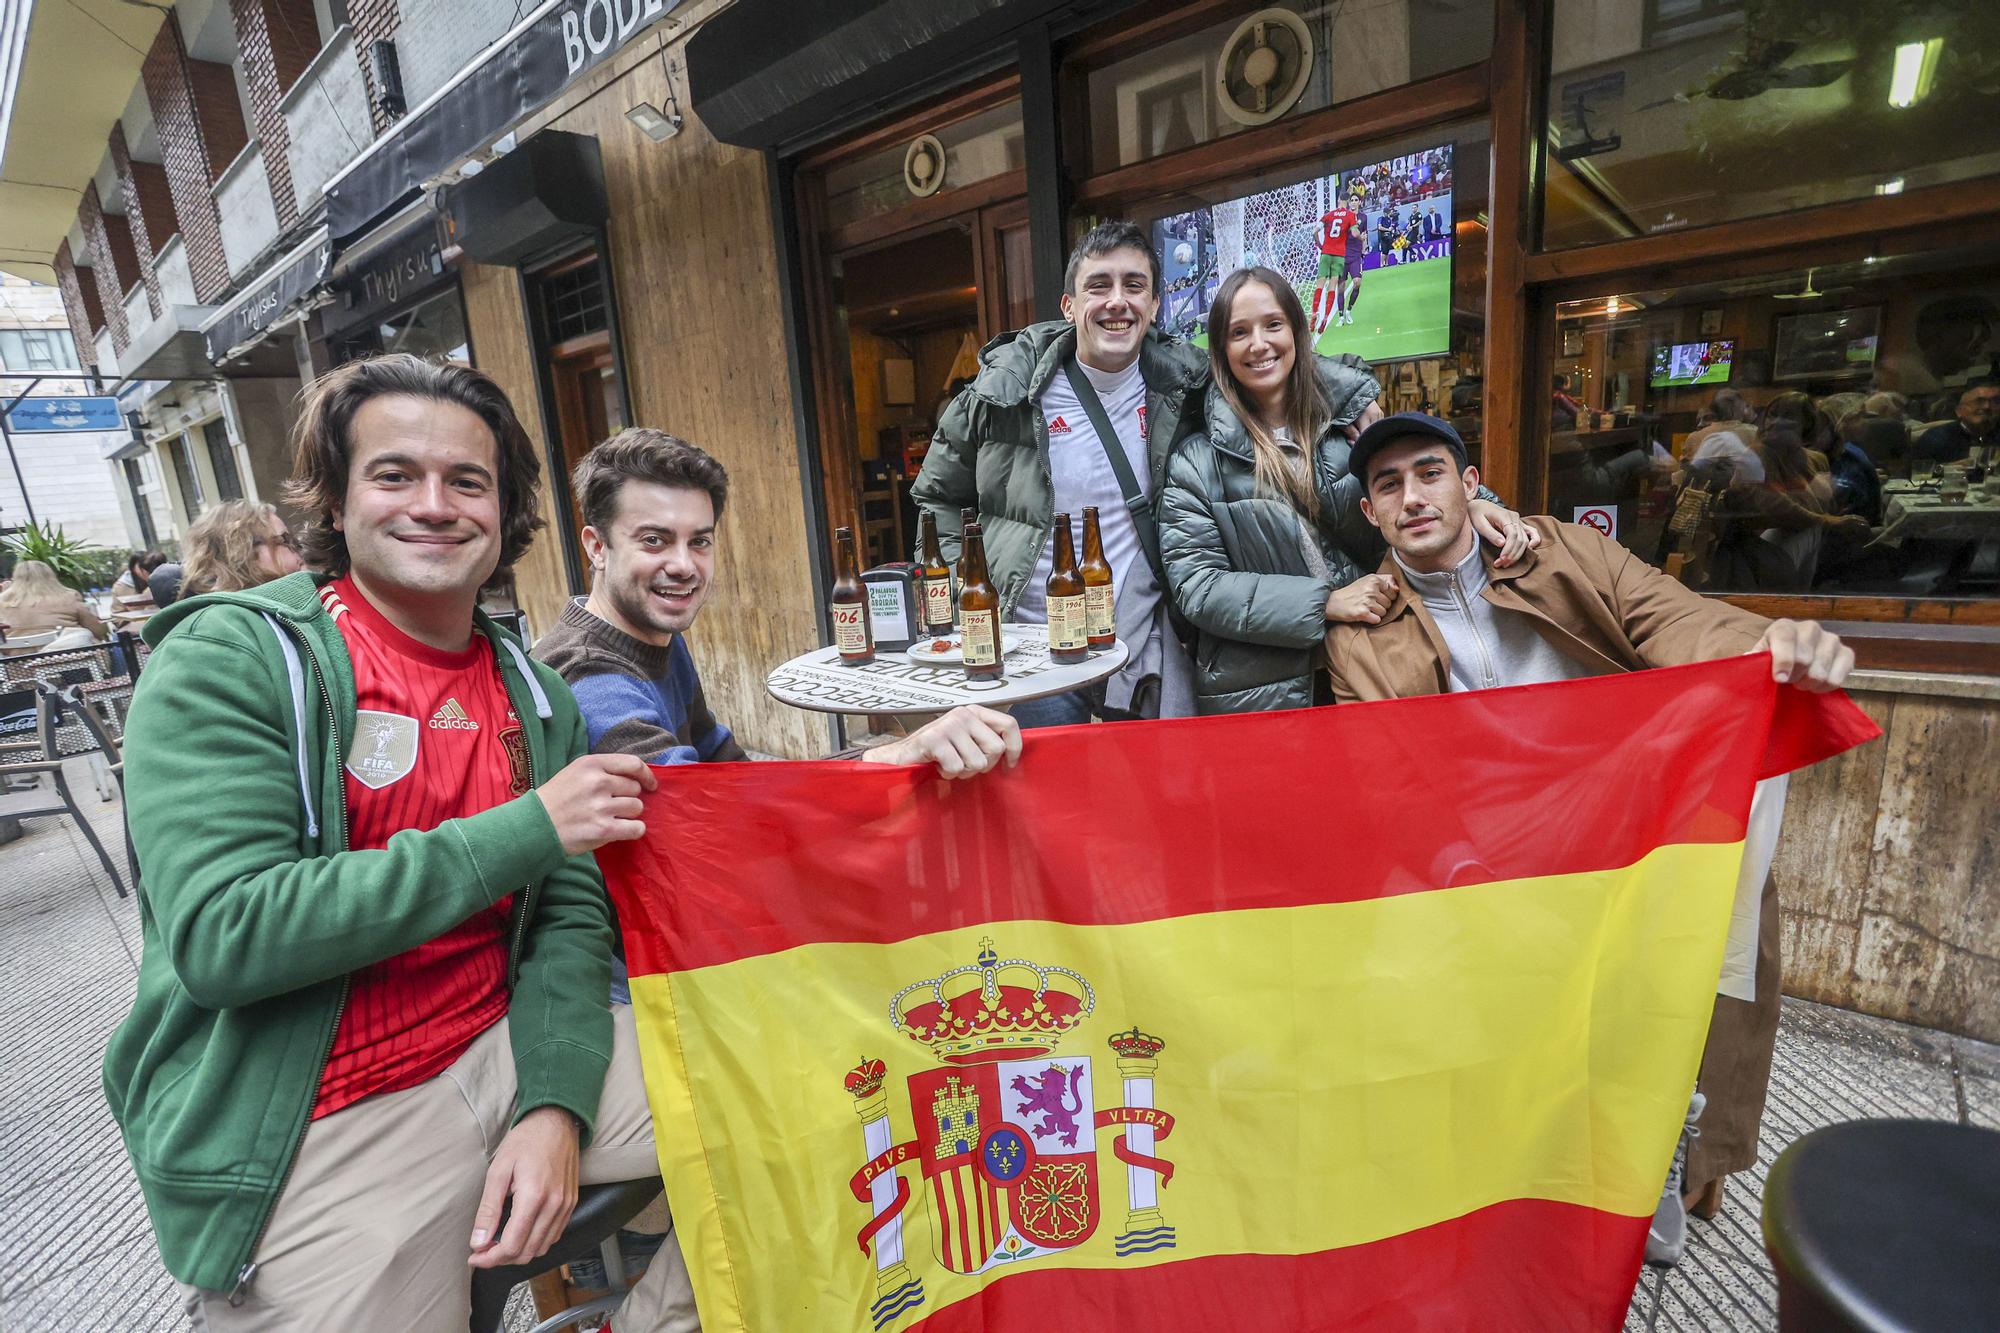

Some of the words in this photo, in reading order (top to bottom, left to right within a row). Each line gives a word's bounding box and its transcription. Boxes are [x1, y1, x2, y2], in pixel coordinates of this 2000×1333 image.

[1417, 168, 1423, 180] 1
[1330, 218, 1342, 238] 6
[1047, 426, 1072, 434] didas
[870, 588, 876, 599] 2
[1065, 601, 1082, 609] 1906
[967, 616, 986, 625] 1906
[820, 656, 1009, 692] CERVEA
[428, 718, 480, 730] adidas
[363, 757, 394, 770] FIFA
[1109, 1109, 1168, 1128] VLTRA
[863, 1146, 906, 1181] PLVS
